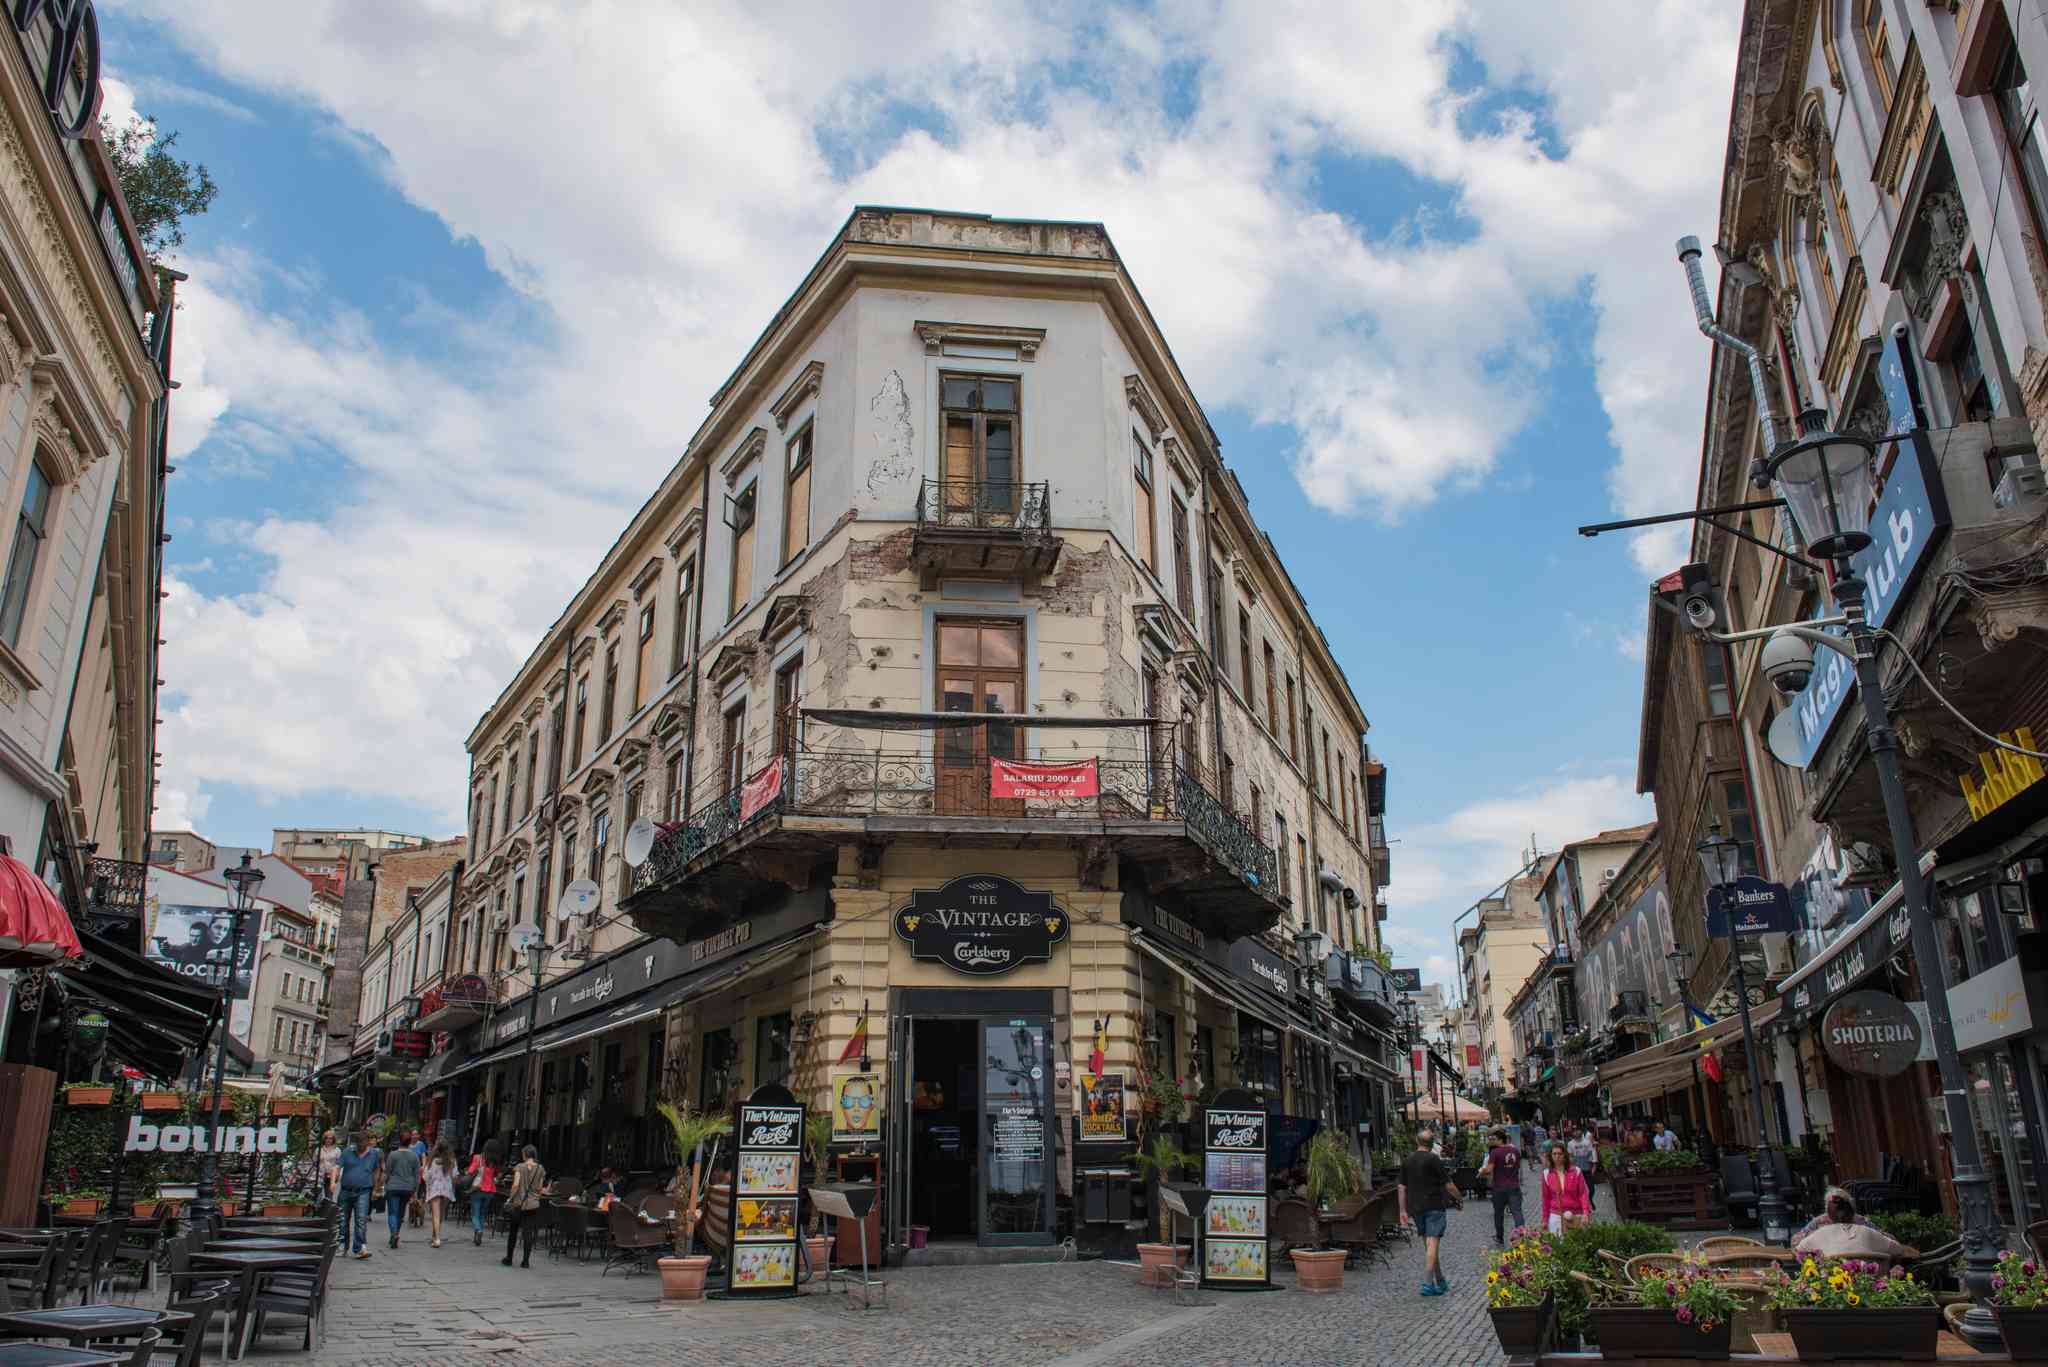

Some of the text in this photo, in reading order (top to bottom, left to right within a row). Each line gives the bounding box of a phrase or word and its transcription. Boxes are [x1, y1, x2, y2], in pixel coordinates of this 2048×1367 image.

[1865, 508, 1913, 626] lub
[1003, 774, 1086, 783] SALARIU 2000 LEI
[969, 895, 998, 905] THE
[1737, 889, 1776, 903] Bankers
[935, 909, 1032, 930] VINTAGE
[953, 941, 1011, 965] Carlsberg
[77, 1018, 109, 1028] bound
[1832, 1024, 1915, 1045] SHOTERIA
[745, 1110, 800, 1125] The Vintage
[1208, 1113, 1264, 1128] The Vintage
[124, 1115, 290, 1153] bound
[1083, 1121, 1121, 1132] COCKTAILS
